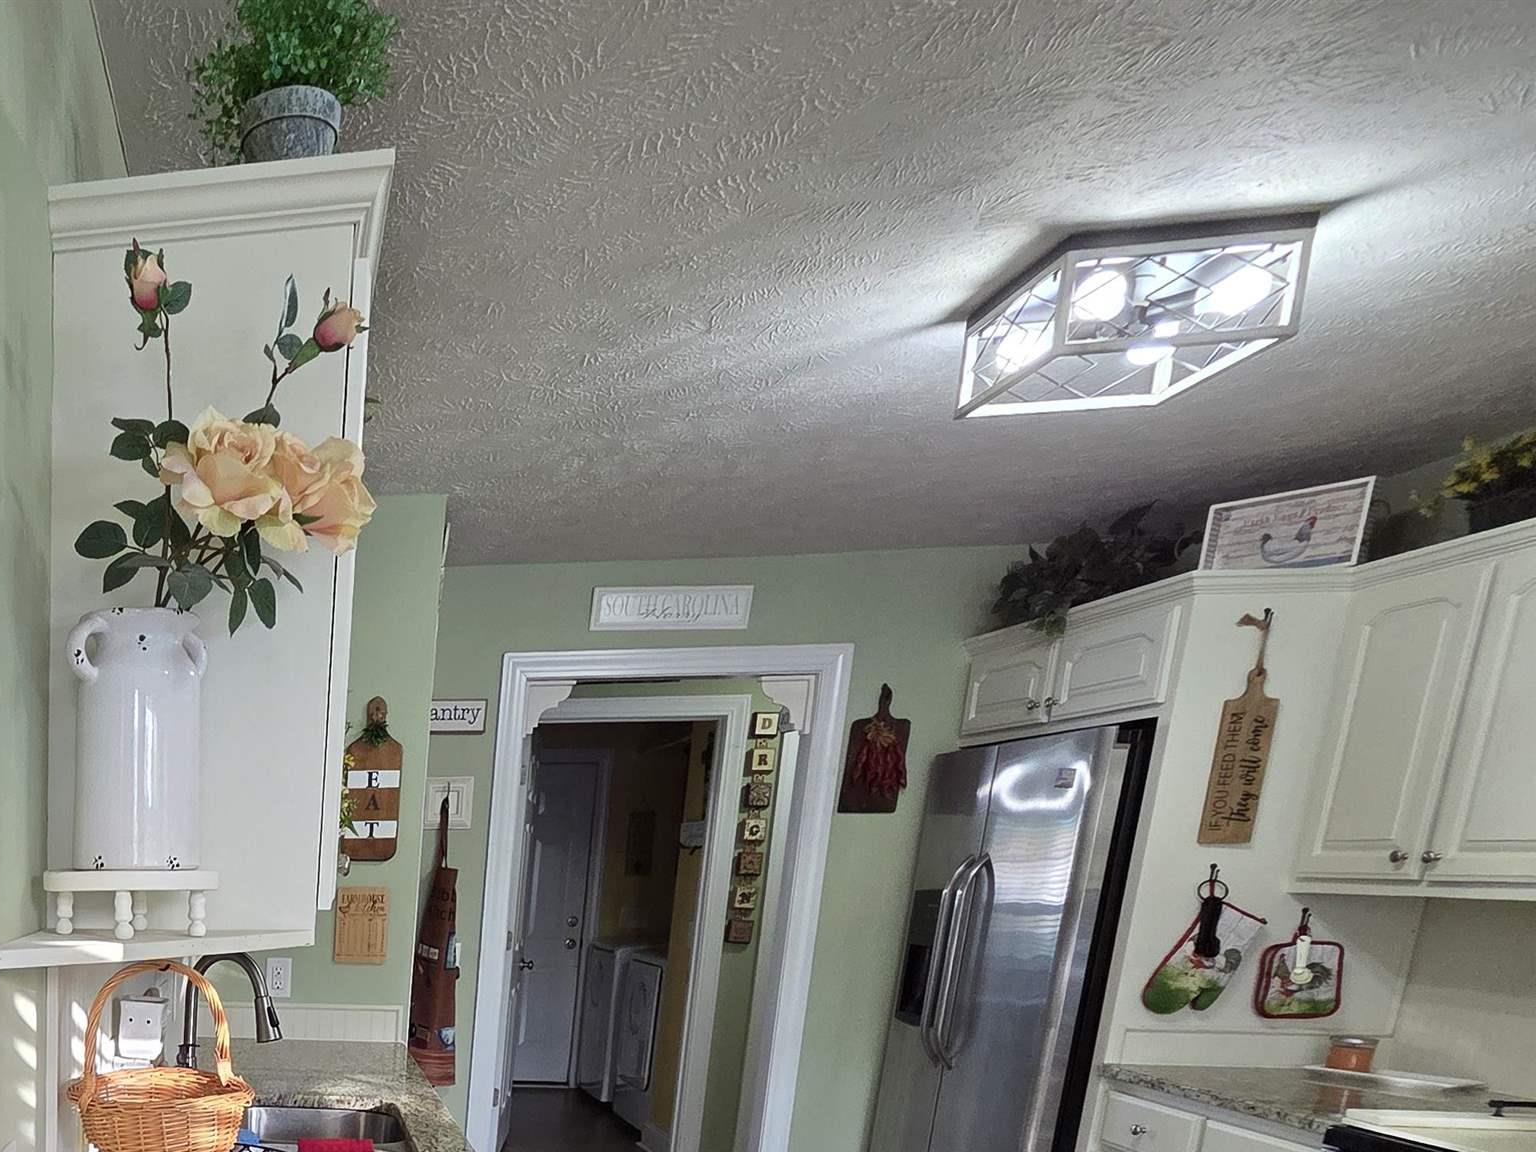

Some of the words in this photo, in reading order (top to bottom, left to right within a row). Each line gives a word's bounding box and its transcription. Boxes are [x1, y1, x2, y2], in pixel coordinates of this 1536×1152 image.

[430, 705, 482, 724] antry
[1224, 711, 1246, 749] THEM
[1245, 715, 1268, 752] come
[1218, 753, 1236, 786] FEED
[1239, 755, 1261, 786] will
[1211, 790, 1229, 818] YOU
[1208, 820, 1222, 831] IF
